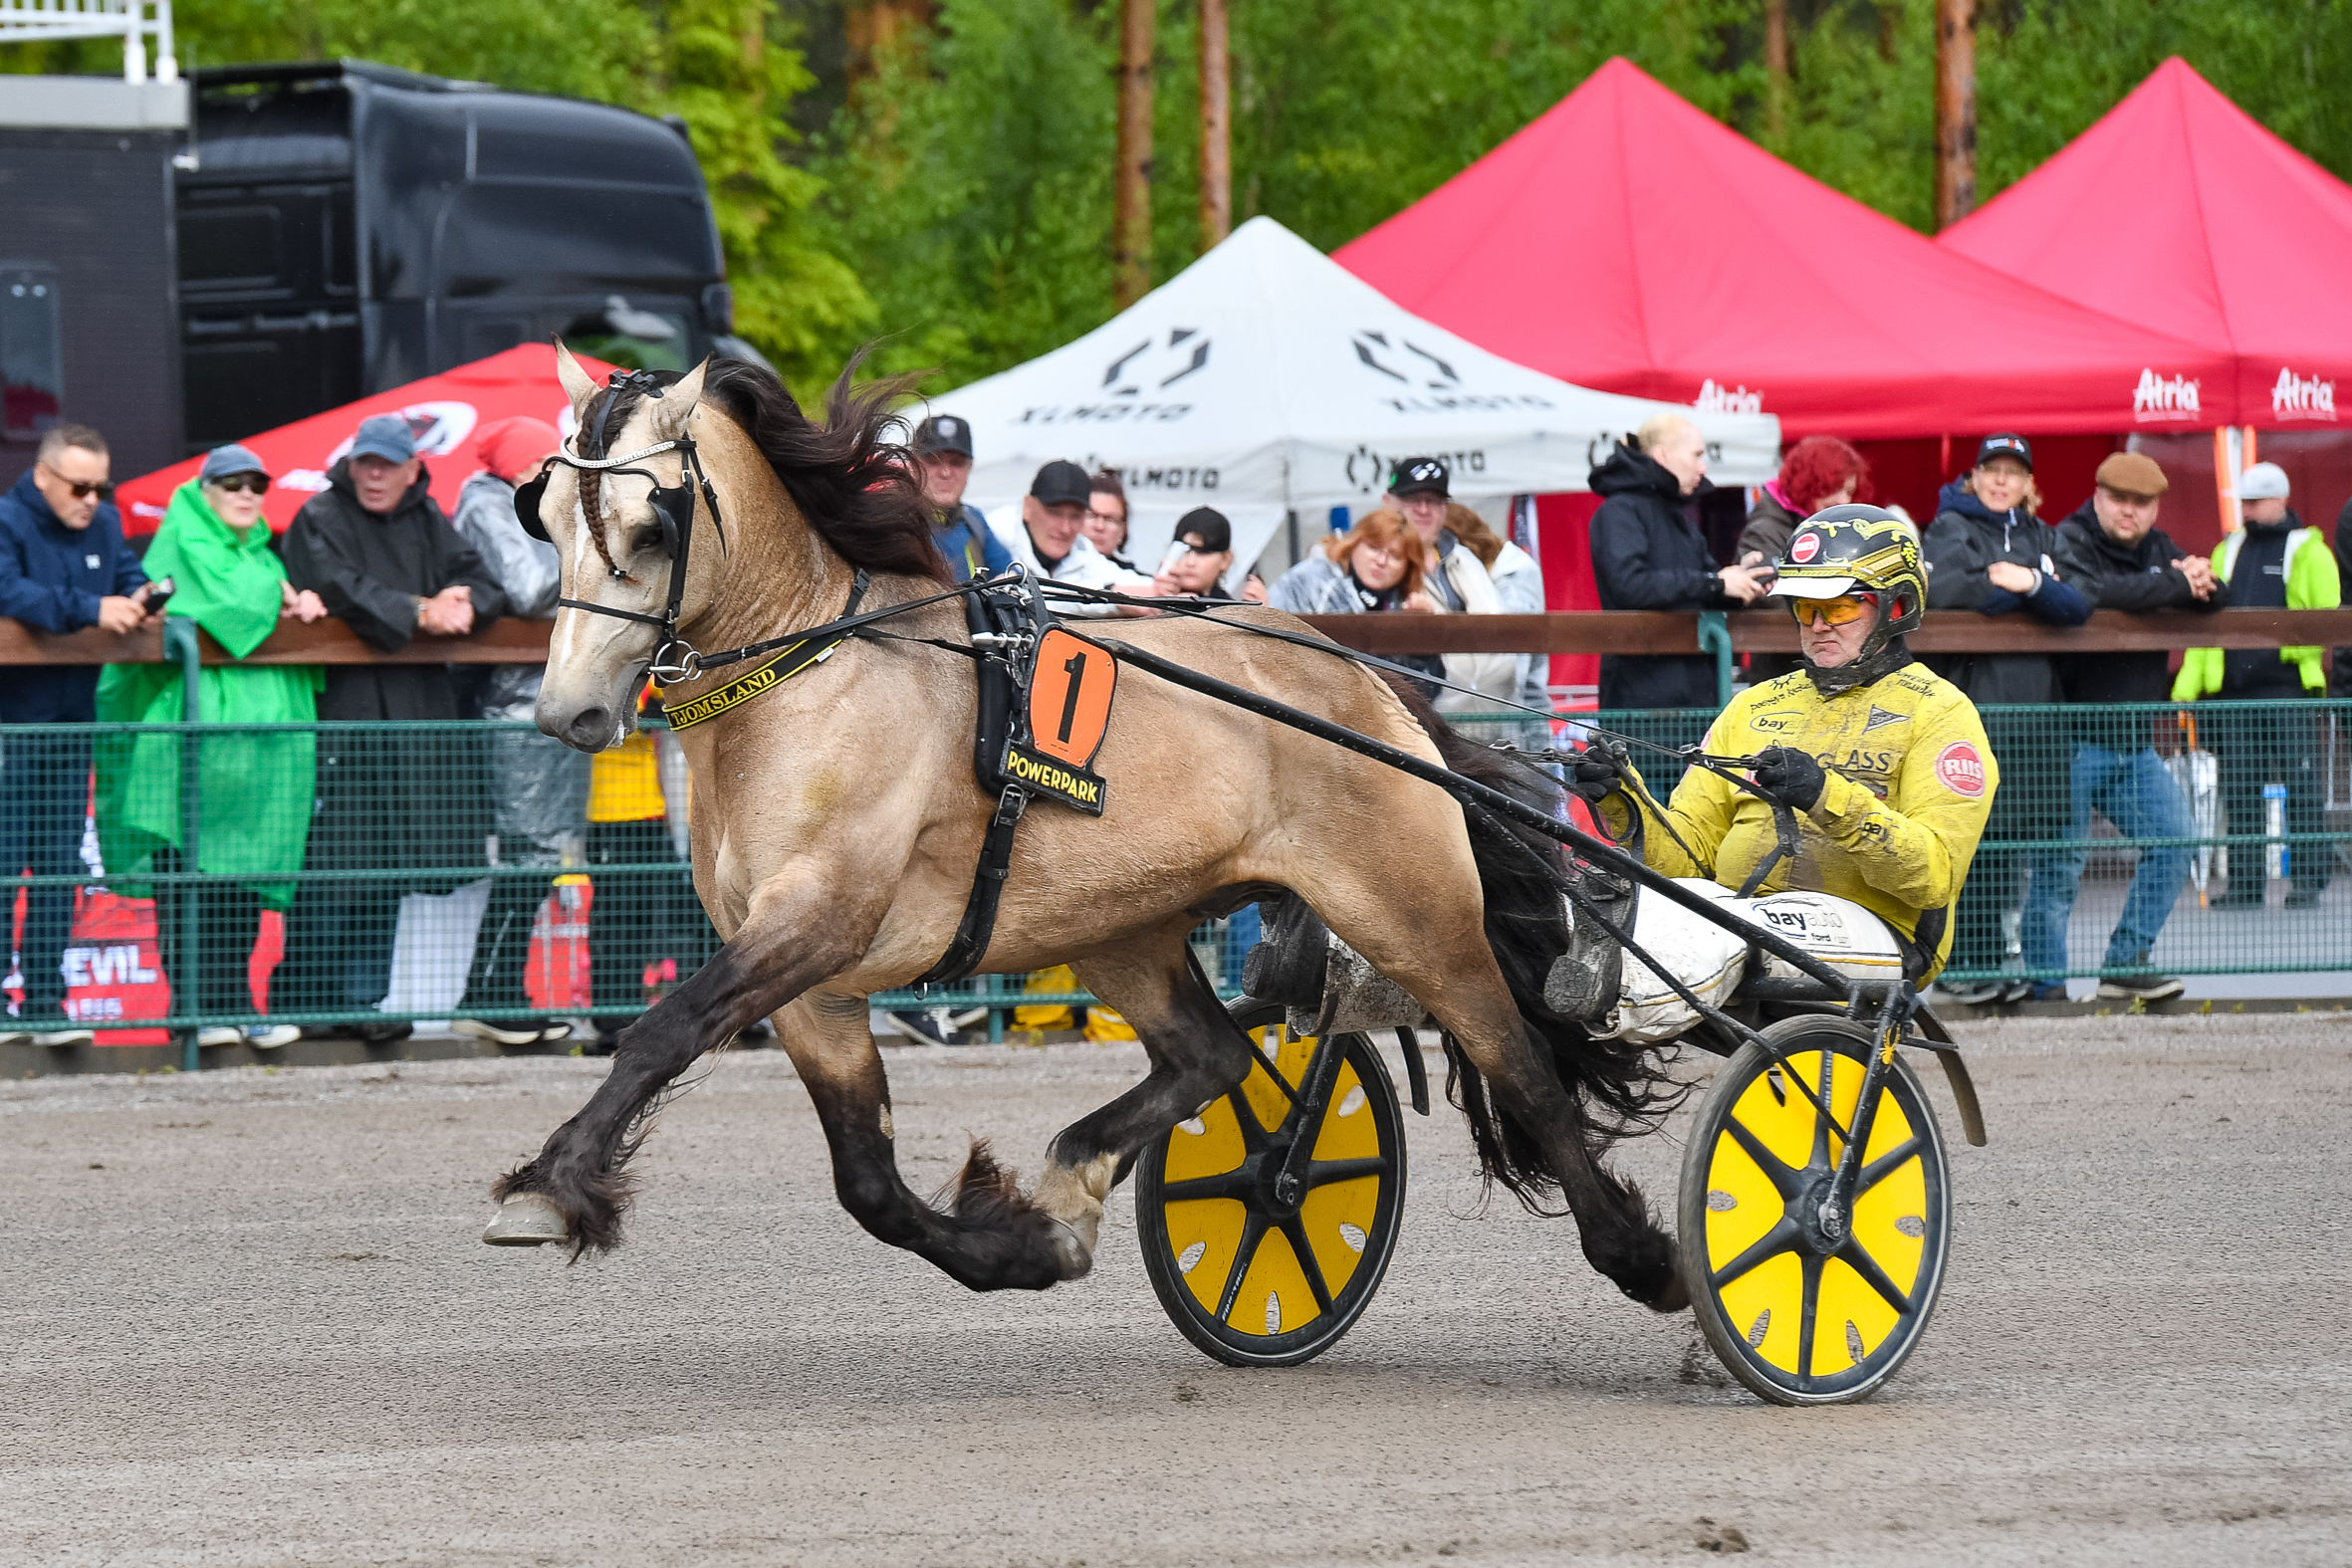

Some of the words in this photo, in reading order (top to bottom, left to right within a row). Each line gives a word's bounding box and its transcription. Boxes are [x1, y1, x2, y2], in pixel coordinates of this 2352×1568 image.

[2133, 367, 2201, 412] Atria
[2271, 366, 2336, 413] Atria
[671, 668, 777, 726] TJOMSLAND
[1054, 650, 1086, 745] 1
[1007, 751, 1098, 803] POWERPARK
